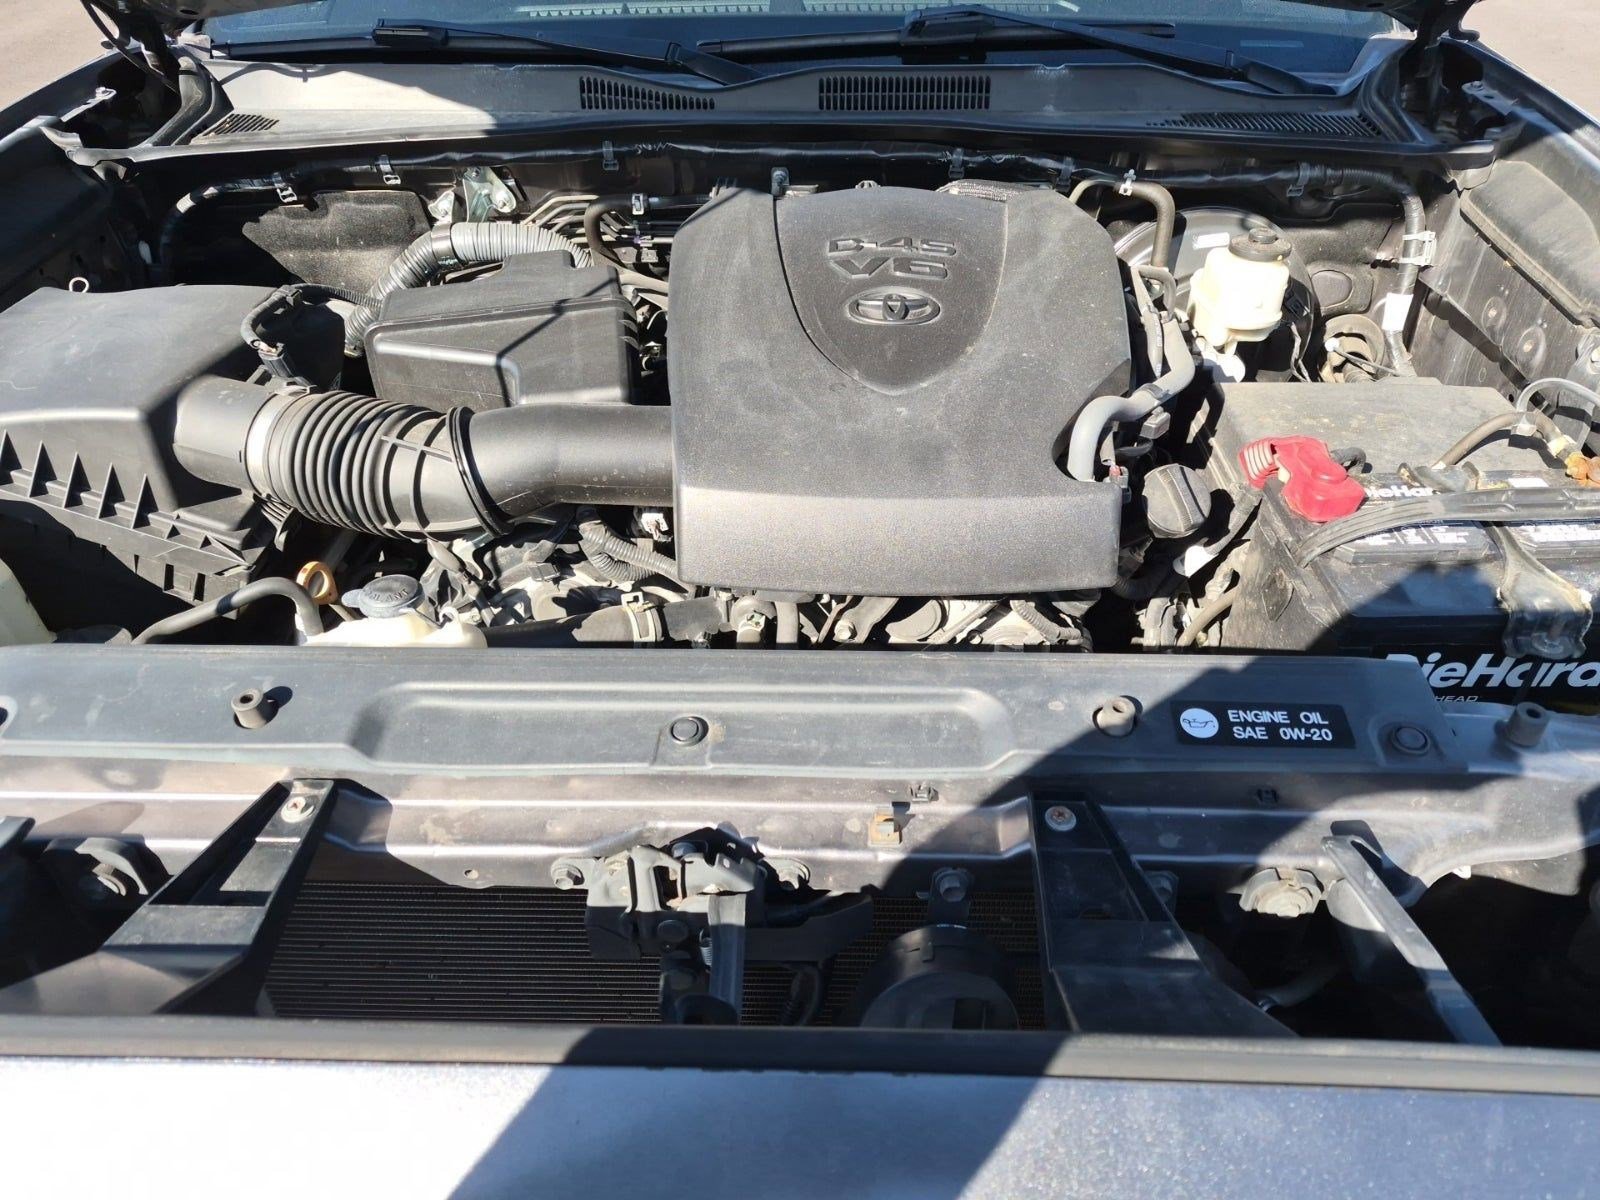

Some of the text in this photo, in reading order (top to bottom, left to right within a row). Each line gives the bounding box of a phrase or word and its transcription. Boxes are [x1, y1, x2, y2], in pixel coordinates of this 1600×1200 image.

[830, 256, 949, 279] V6
[1386, 652, 1600, 688] ieHard
[1227, 709, 1329, 725] ENGINE OIL
[1232, 726, 1333, 741] SAE 0W-20
